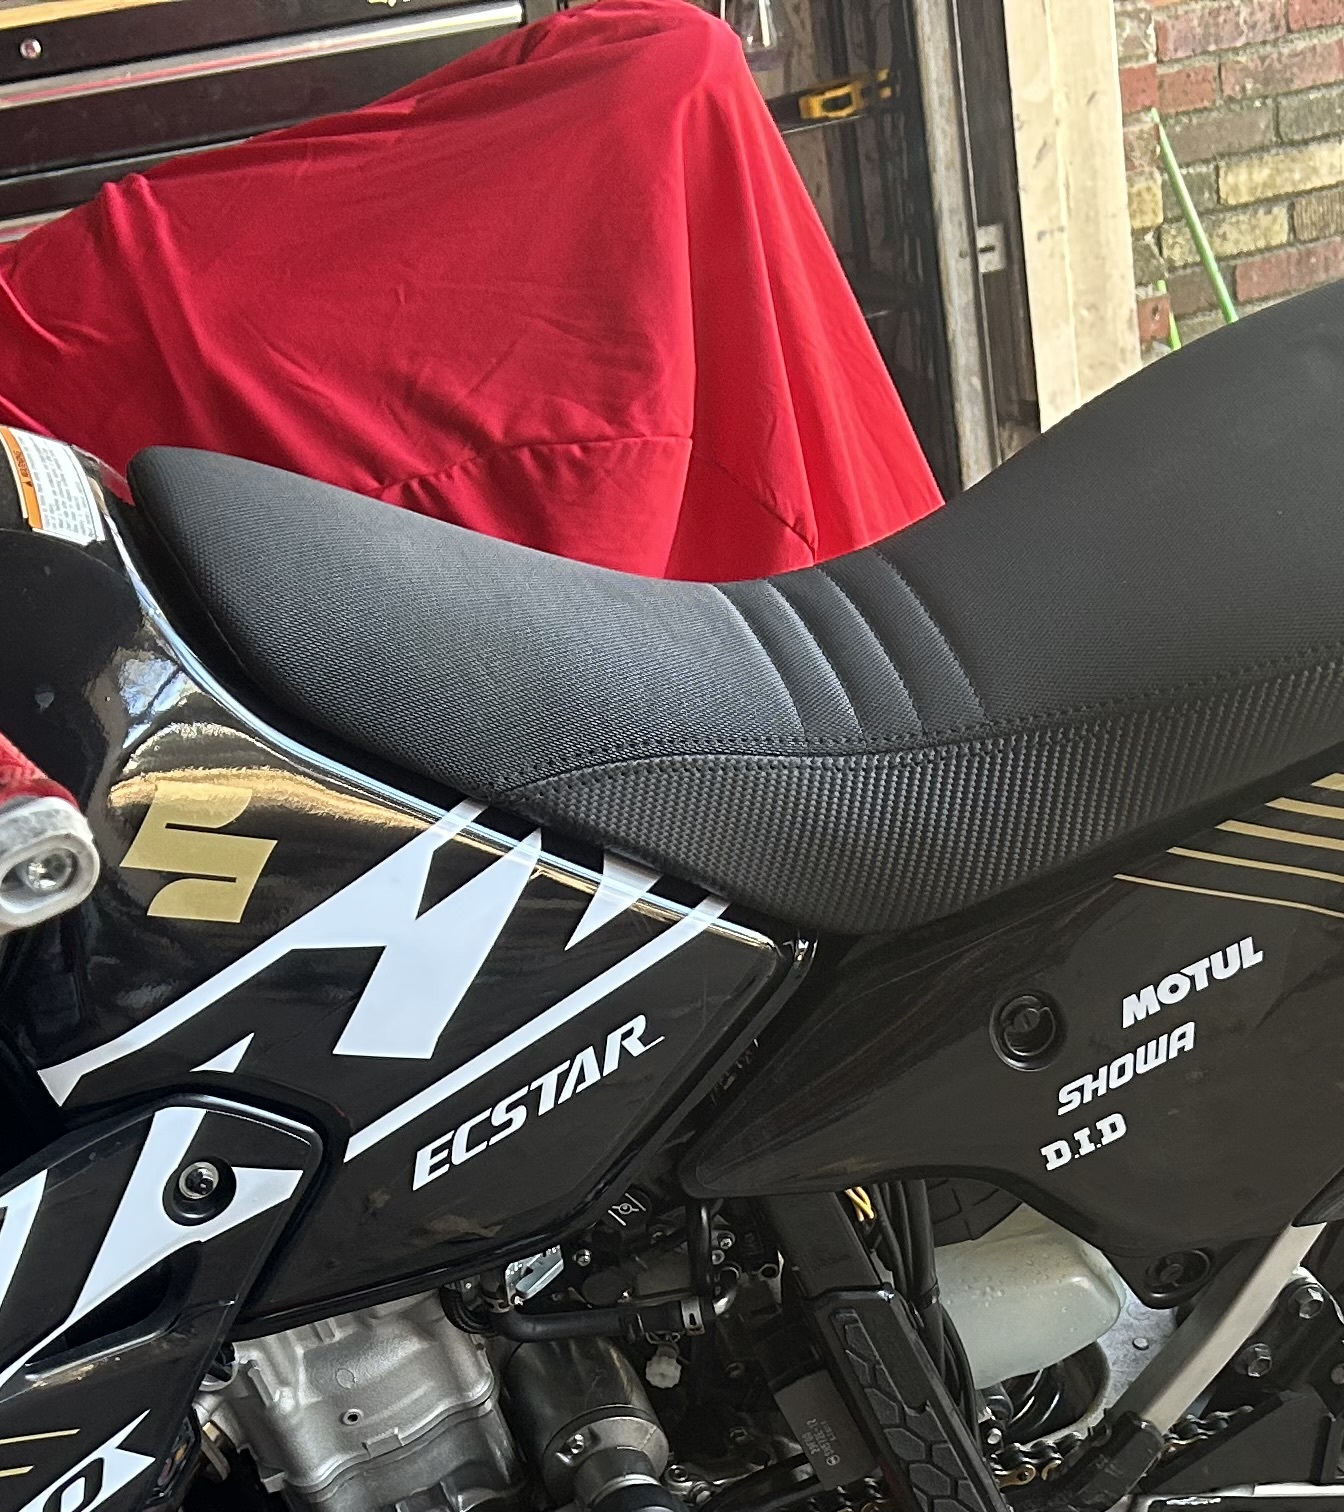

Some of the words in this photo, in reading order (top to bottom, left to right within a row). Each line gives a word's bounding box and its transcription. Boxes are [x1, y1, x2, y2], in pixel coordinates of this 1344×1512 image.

[1122, 936, 1264, 1029] MOTUL
[412, 1014, 665, 1191] ECSTAR
[1057, 1021, 1196, 1116] SHOWA
[1040, 1112, 1127, 1171] D.I.D
